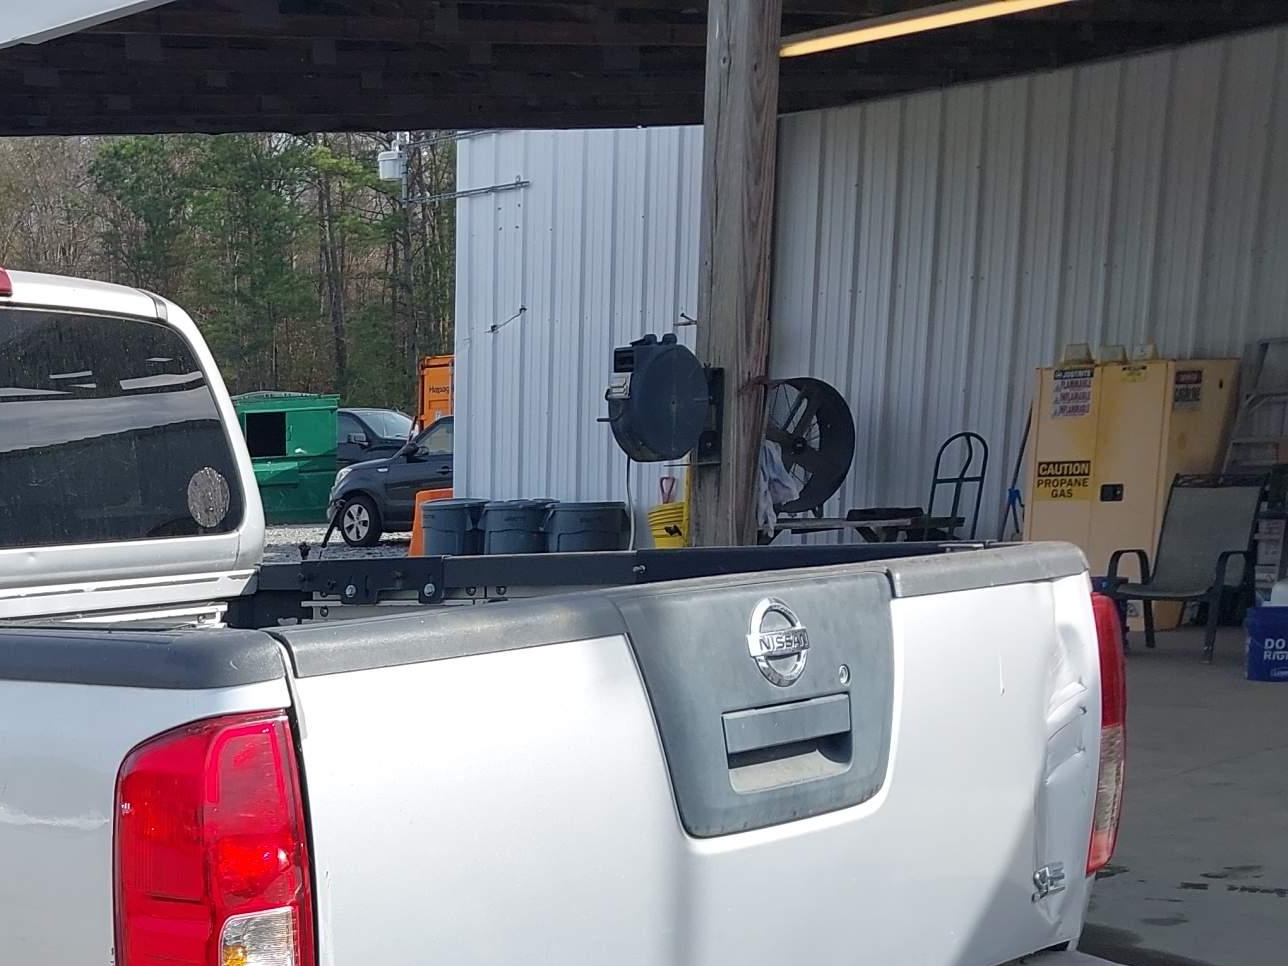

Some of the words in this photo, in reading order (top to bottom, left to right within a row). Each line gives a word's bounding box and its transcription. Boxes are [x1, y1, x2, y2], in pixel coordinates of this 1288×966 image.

[1039, 462, 1089, 476] CAUTION
[1037, 477, 1089, 488] PROPANE
[1051, 488, 1073, 498] GAS
[759, 631, 809, 651] NISSAN
[1264, 638, 1286, 650] DO
